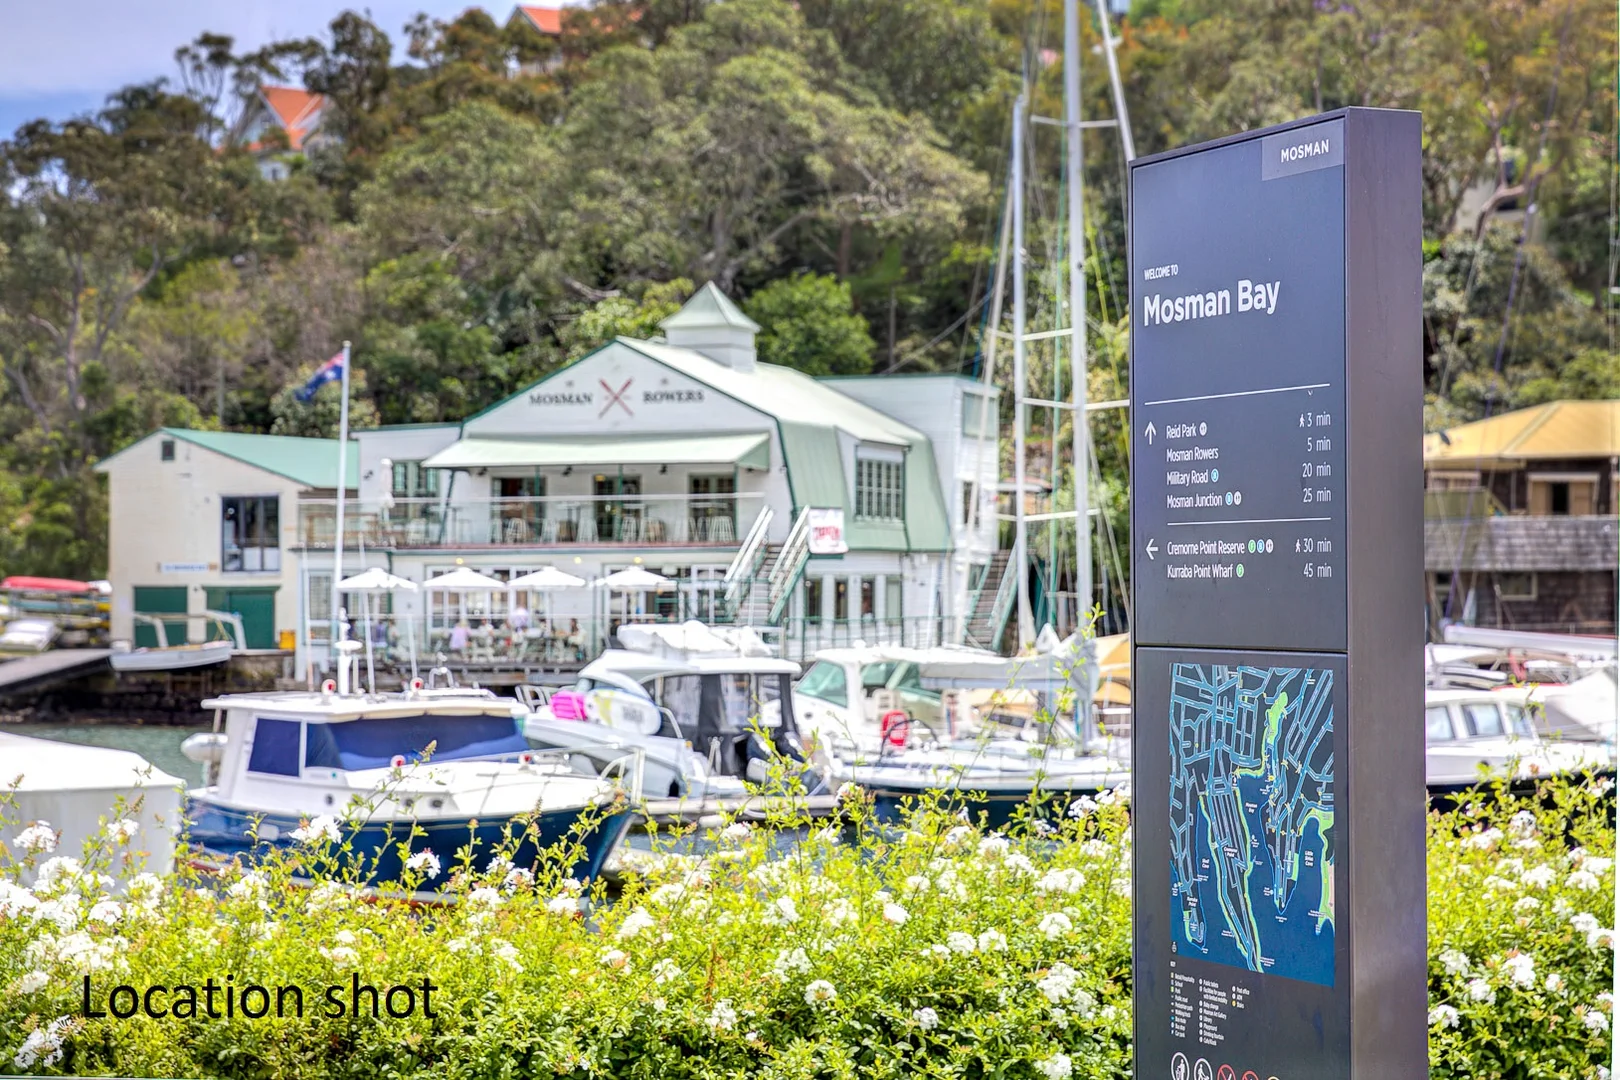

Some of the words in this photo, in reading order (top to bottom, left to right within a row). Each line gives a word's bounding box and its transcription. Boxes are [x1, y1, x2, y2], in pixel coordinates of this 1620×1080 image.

[1281, 139, 1329, 162] MOSMAN
[1144, 266, 1170, 280] WELCOME
[1171, 264, 1178, 275] TO
[1144, 289, 1230, 326] Mosman
[1238, 279, 1280, 314] Bay
[530, 392, 592, 405] MOSMAN
[643, 389, 704, 402] ROWERS
[1166, 426, 1181, 439] Reid
[1182, 423, 1196, 437] Park
[1307, 412, 1312, 427] 3
[1316, 411, 1331, 426] min
[1166, 449, 1193, 462] Mosman
[1194, 447, 1218, 460] Rowers
[1307, 437, 1312, 452] 5
[1316, 436, 1331, 451] min
[1166, 472, 1190, 486] Military
[1191, 470, 1208, 484] Road
[1302, 463, 1312, 478] 20
[1316, 462, 1331, 476] min
[1166, 495, 1193, 508] Mosman
[1194, 493, 1222, 508] Junction
[1303, 488, 1312, 502] 25
[1316, 487, 1332, 502] min
[1167, 541, 1198, 555] Cremorne
[1200, 540, 1217, 554] Point
[1218, 540, 1245, 554] Reserve
[1303, 538, 1314, 553] 30
[1317, 538, 1332, 552] min
[1167, 565, 1192, 578] Kurraba
[1194, 564, 1211, 578] Point
[1212, 563, 1234, 578] Wharf
[1304, 563, 1314, 578] 45
[1317, 563, 1332, 578] min
